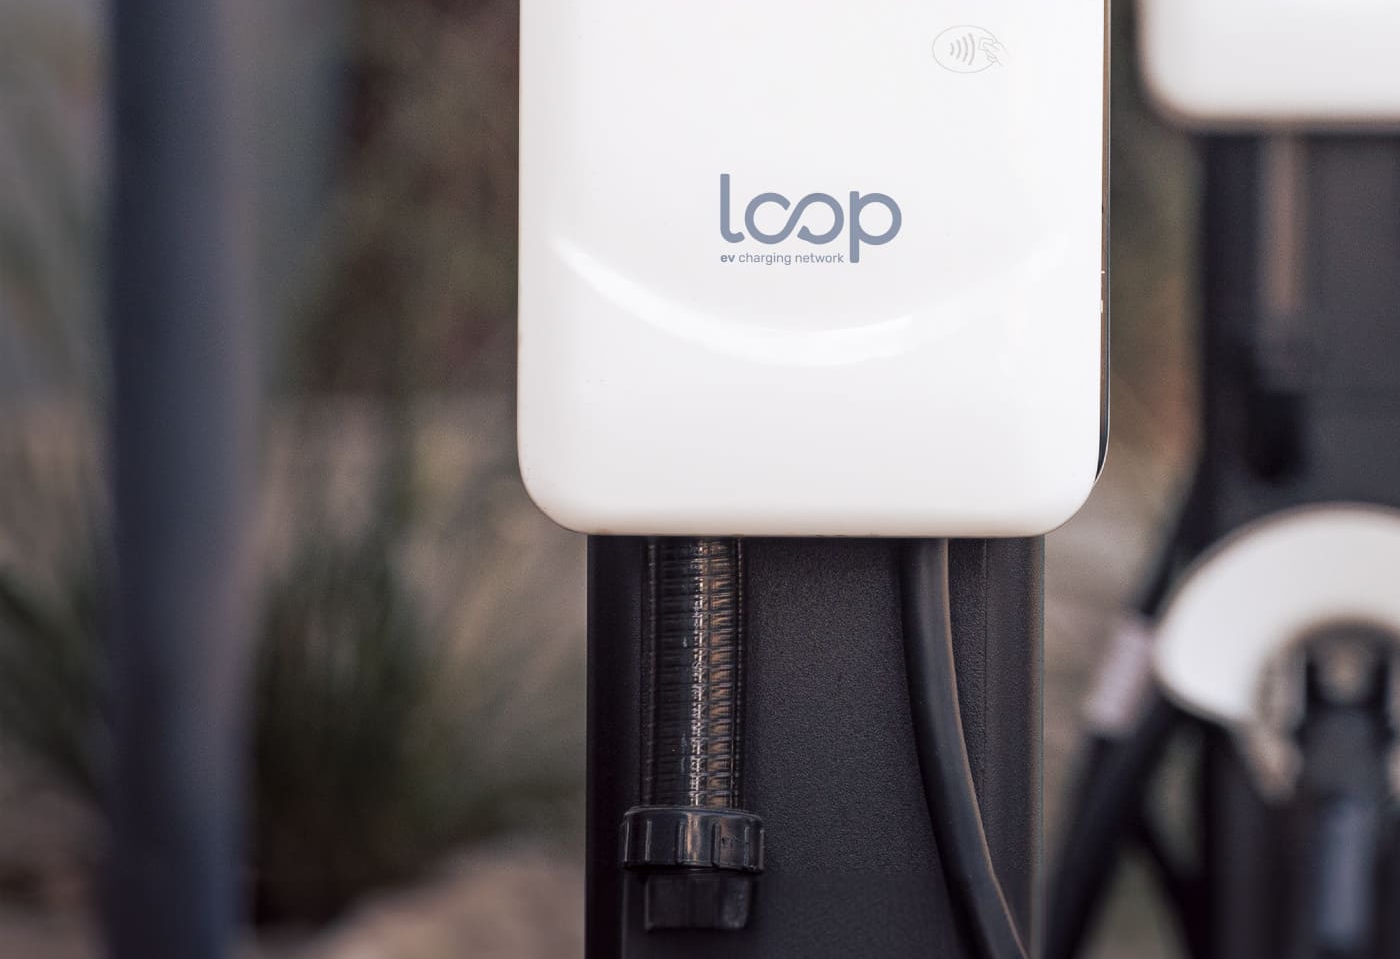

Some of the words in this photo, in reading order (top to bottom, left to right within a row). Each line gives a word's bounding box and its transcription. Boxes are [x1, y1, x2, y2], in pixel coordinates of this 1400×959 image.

[720, 173, 902, 263] loop
[720, 255, 736, 263] ev
[738, 252, 792, 266] charging
[795, 252, 844, 263] network
